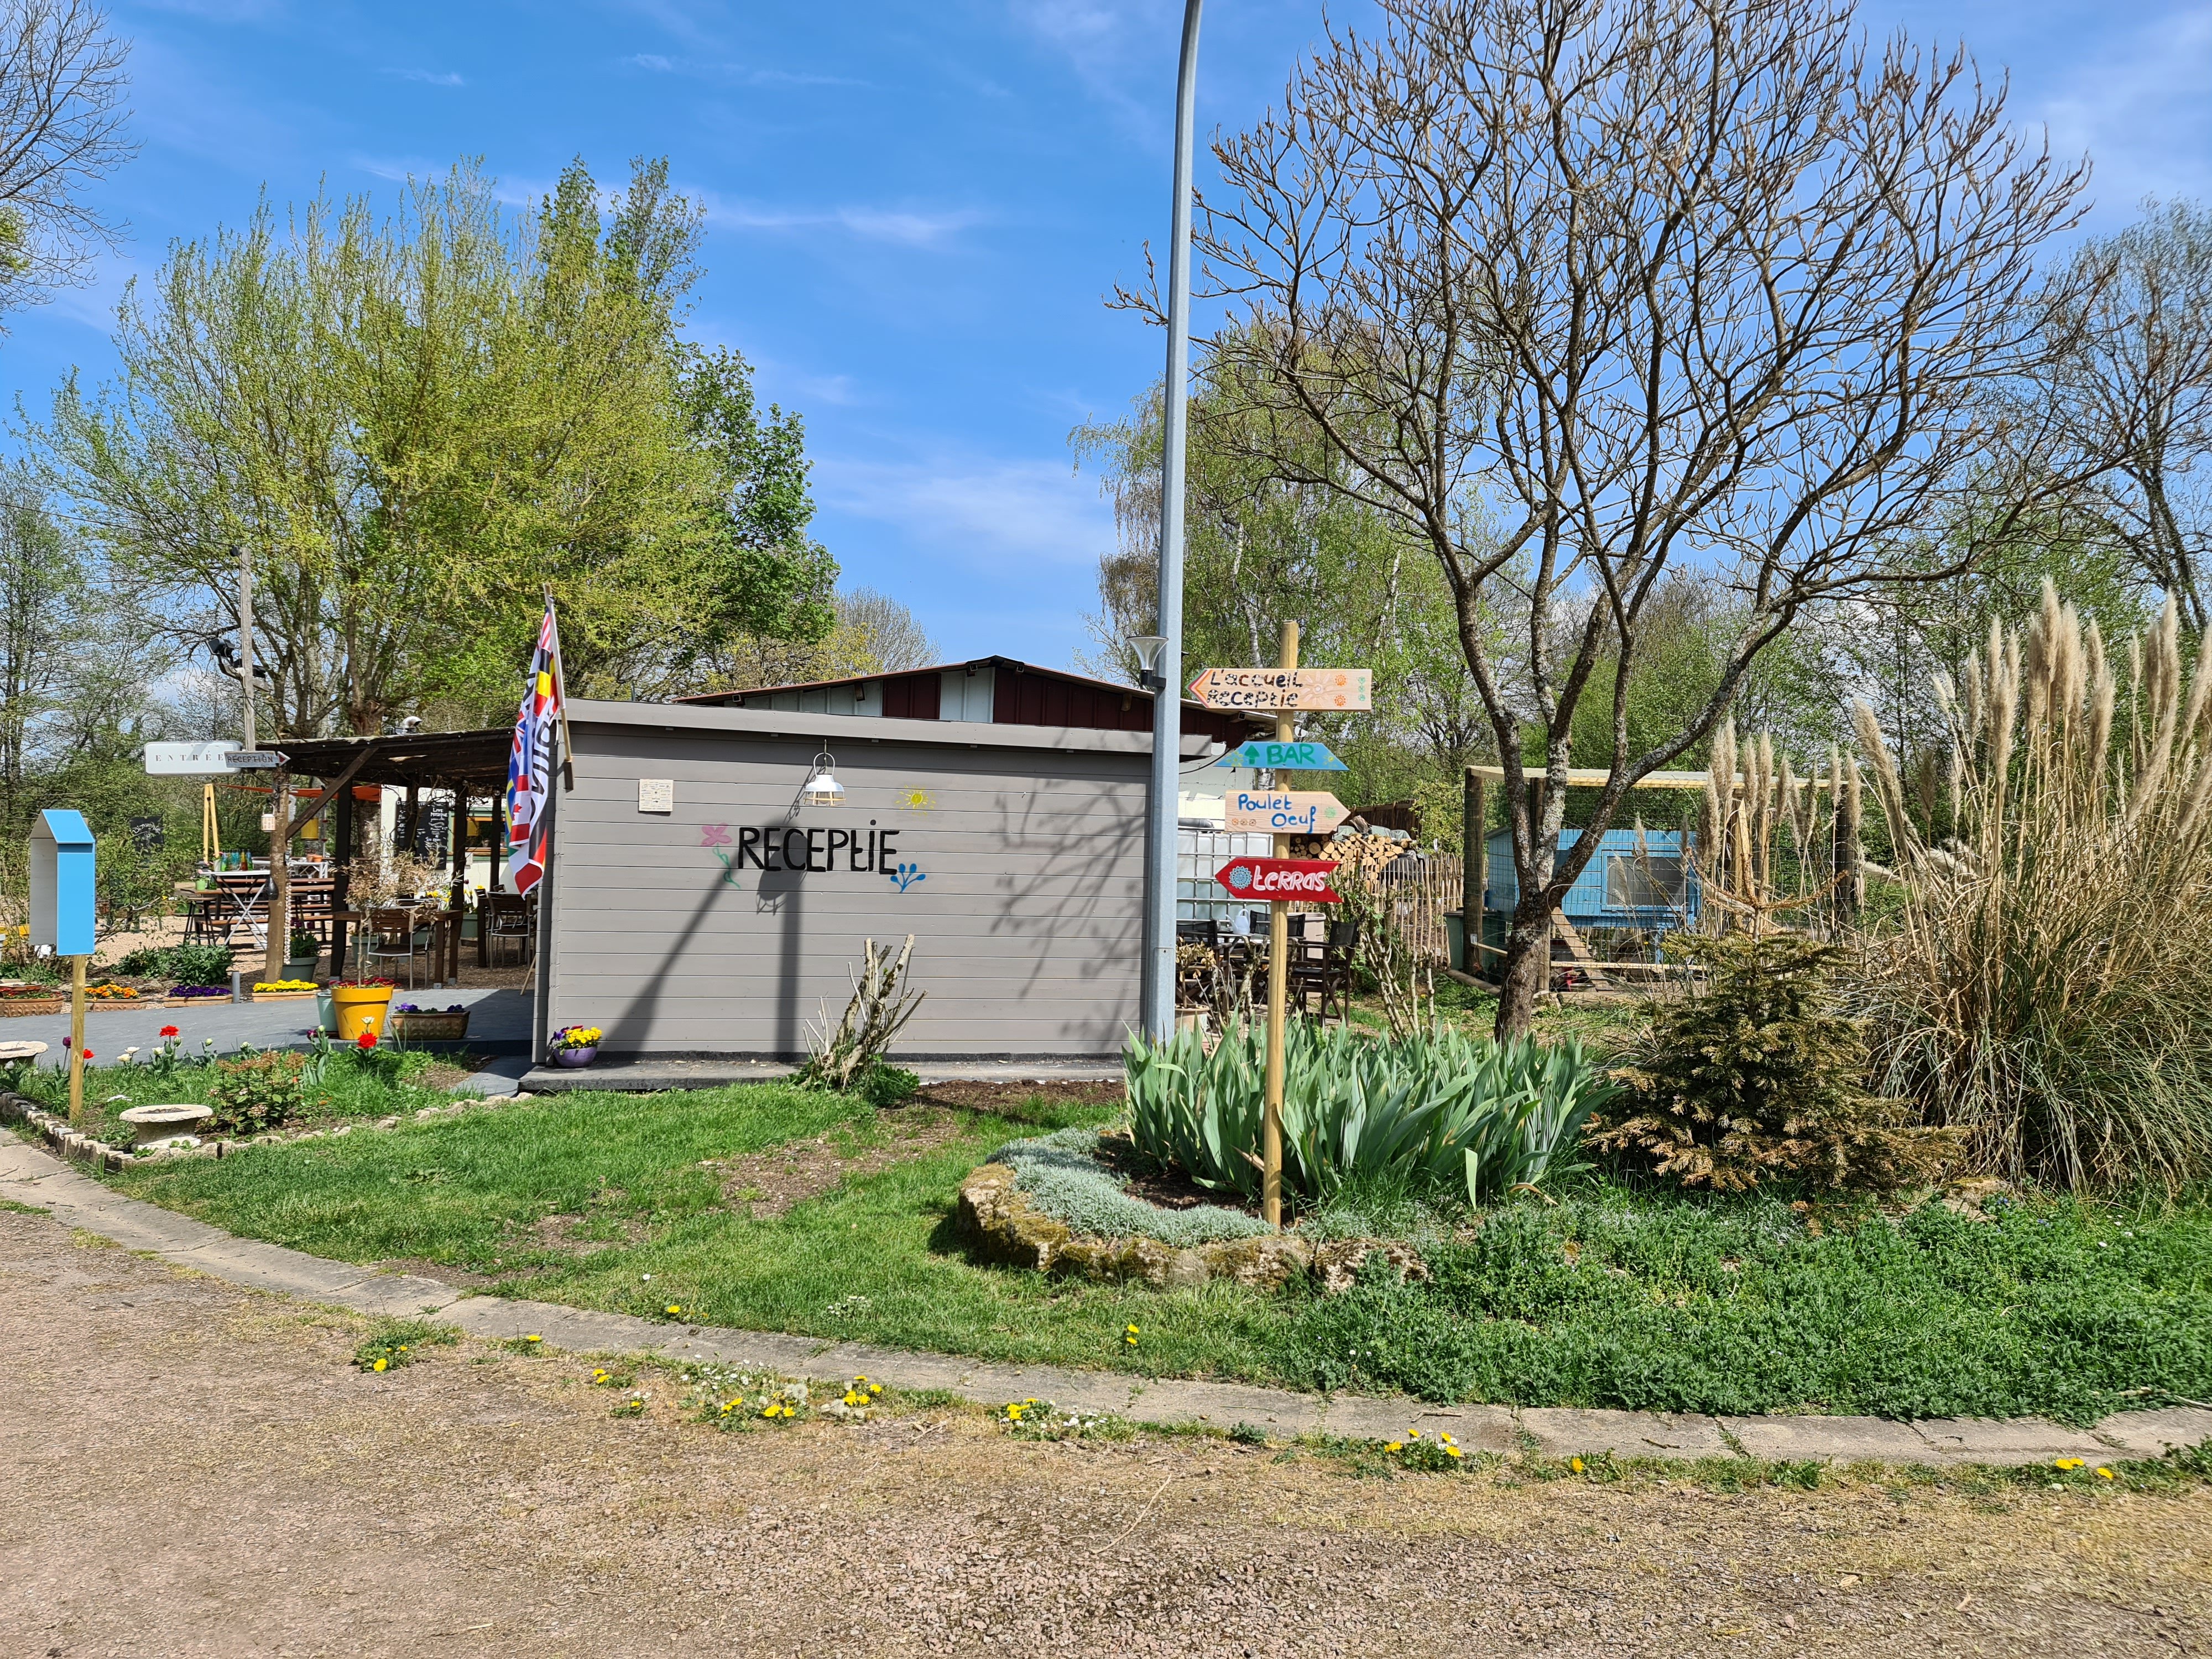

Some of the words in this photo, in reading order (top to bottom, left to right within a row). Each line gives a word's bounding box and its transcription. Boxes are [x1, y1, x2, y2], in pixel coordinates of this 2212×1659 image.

[155, 750, 223, 761] ENTRÉE
[1266, 744, 1316, 765] BAR
[1238, 793, 1292, 811] Poulet
[1271, 805, 1316, 834] Oeuf
